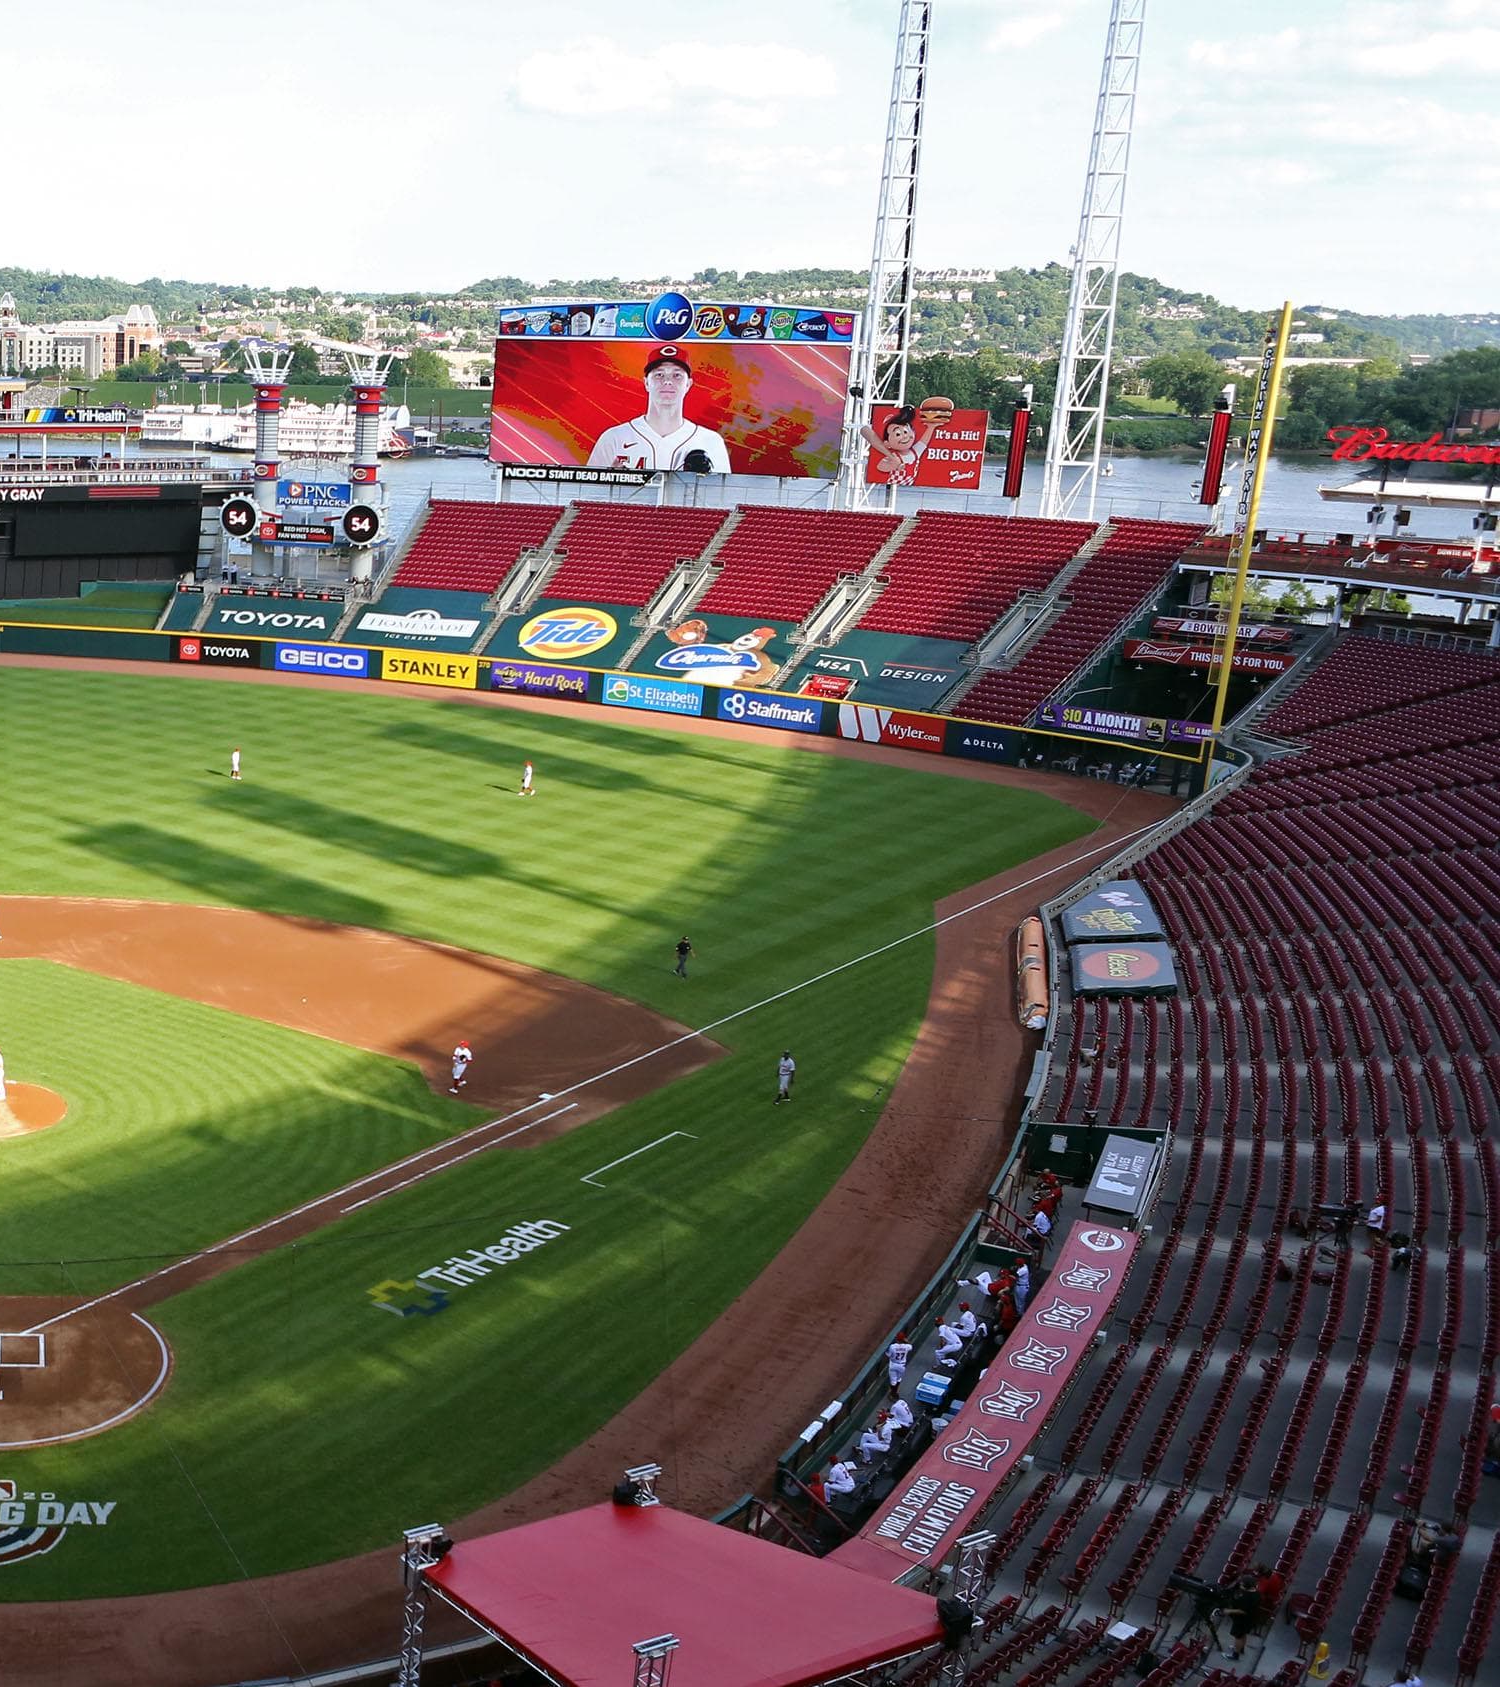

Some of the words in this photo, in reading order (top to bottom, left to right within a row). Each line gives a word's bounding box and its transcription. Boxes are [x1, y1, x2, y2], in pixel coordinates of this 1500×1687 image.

[619, 319, 644, 329] Pampers
[655, 308, 690, 326] P&G
[695, 314, 722, 332] Tide
[76, 409, 127, 423] TriHealth
[935, 429, 952, 440] It's
[960, 430, 980, 441] Hit!
[1248, 429, 1261, 463] WAY
[927, 448, 950, 461] BIG
[952, 449, 979, 462] BOY
[505, 467, 547, 479] NOCO
[549, 470, 575, 481] START
[576, 472, 598, 482] DEAD
[10, 488, 45, 501] GRAY
[304, 485, 338, 499] PNC
[1238, 470, 1254, 515] FAIR
[279, 497, 310, 505] POWER
[229, 511, 247, 526] 54
[351, 517, 370, 532] 54
[219, 609, 327, 630] TOYOTA
[368, 616, 473, 633] HOMEMADE
[518, 619, 610, 648] Tide
[1193, 623, 1228, 635] BOWTIE
[404, 634, 437, 642] CREAM
[203, 645, 249, 658] TOYOTA
[280, 648, 365, 671] GEICO
[668, 650, 743, 665] Charmin
[1137, 646, 1182, 659] Budweiser
[388, 658, 470, 680] STANLEY
[815, 658, 852, 673] MSA
[1190, 651, 1211, 662] THIS
[1212, 653, 1241, 665] BU'S
[1243, 656, 1261, 668] FOR
[1263, 658, 1285, 671] YOU.
[523, 671, 554, 688] Hard
[555, 676, 585, 693] Rock
[879, 667, 948, 684] DESIGN
[645, 687, 699, 705] Elizabeth
[643, 699, 699, 711] HEALTHCARE
[1062, 707, 1082, 724] $10
[1083, 711, 1093, 725] A
[1094, 711, 1141, 732] MONTH
[888, 722, 941, 743] Wyler.com
[973, 738, 1005, 750] DELTA
[1103, 1151, 1120, 1168] BLACK
[1117, 1157, 1132, 1169] LIVES
[1129, 1155, 1145, 1179] MATTER
[1095, 1231, 1109, 1248] REDS
[417, 1218, 572, 1287] TriHealth
[1067, 1268, 1104, 1290] 1990
[1050, 1304, 1086, 1329] 1976
[895, 1352, 906, 1361] 27
[1017, 1344, 1057, 1372] 1975
[987, 1390, 1034, 1418] 1940
[950, 1438, 1002, 1468] 1919
[22, 1491, 56, 1500] 20
[37, 1501, 118, 1525] DAY
[876, 1505, 919, 1541] WORLD
[904, 1475, 942, 1515] SERIES
[902, 1482, 977, 1556] CHAMPIONS
